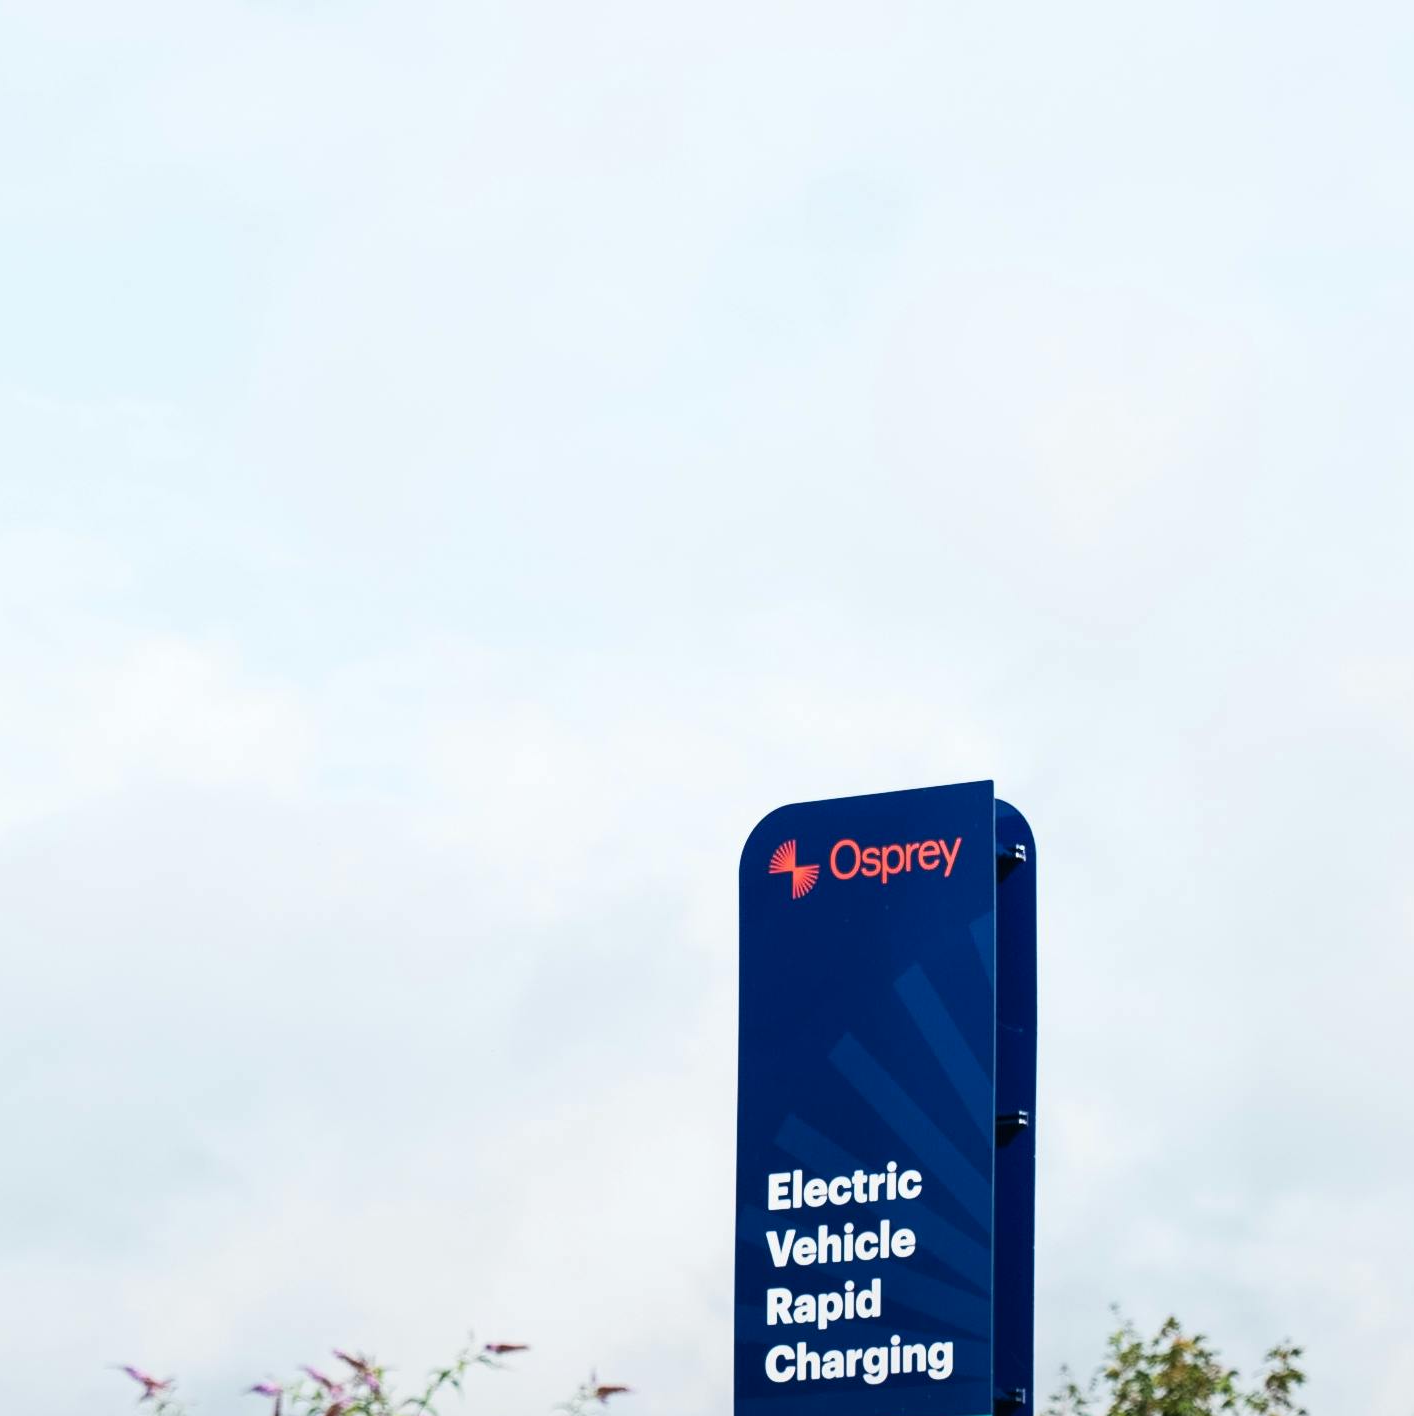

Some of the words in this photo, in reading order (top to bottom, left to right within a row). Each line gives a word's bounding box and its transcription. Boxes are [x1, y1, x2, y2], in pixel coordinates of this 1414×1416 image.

[830, 837, 962, 884] Osprey
[767, 1160, 923, 1211] Electric
[765, 1219, 917, 1268] Vehicle
[766, 1277, 882, 1330] Rapid
[764, 1334, 954, 1385] Charging
